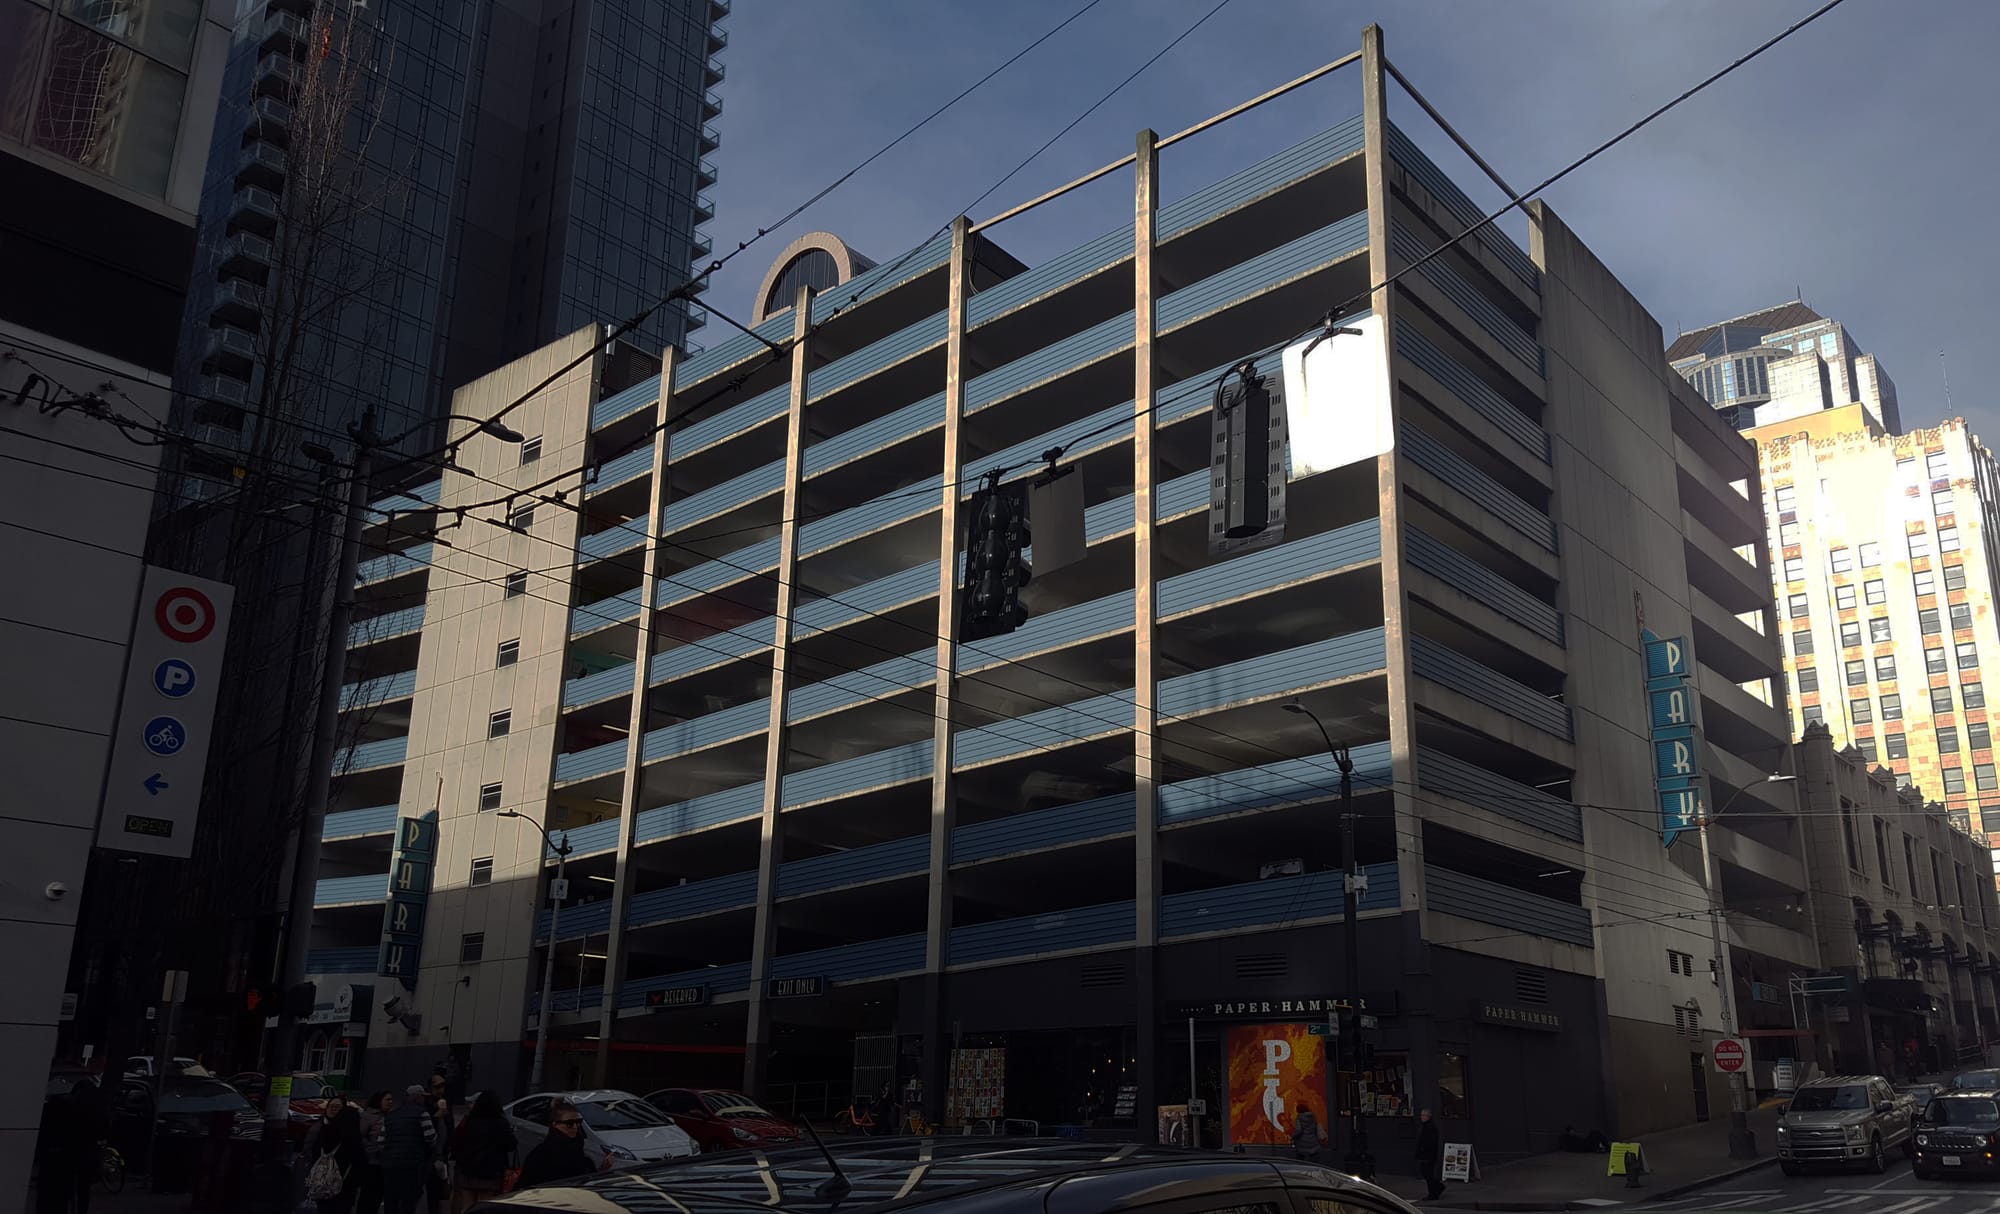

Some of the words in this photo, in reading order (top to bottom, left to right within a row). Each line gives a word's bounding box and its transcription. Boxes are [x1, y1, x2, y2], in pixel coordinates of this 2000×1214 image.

[162, 665, 191, 691] P
[128, 817, 169, 834] OPEN
[777, 979, 794, 996] EXIT
[796, 977, 817, 994] ONLY
[663, 987, 698, 1005] RESERVED
[1214, 1001, 1271, 1015] PAPER
[1486, 1006, 1517, 1020] PAPER
[1521, 1010, 1560, 1026] HAMMER
